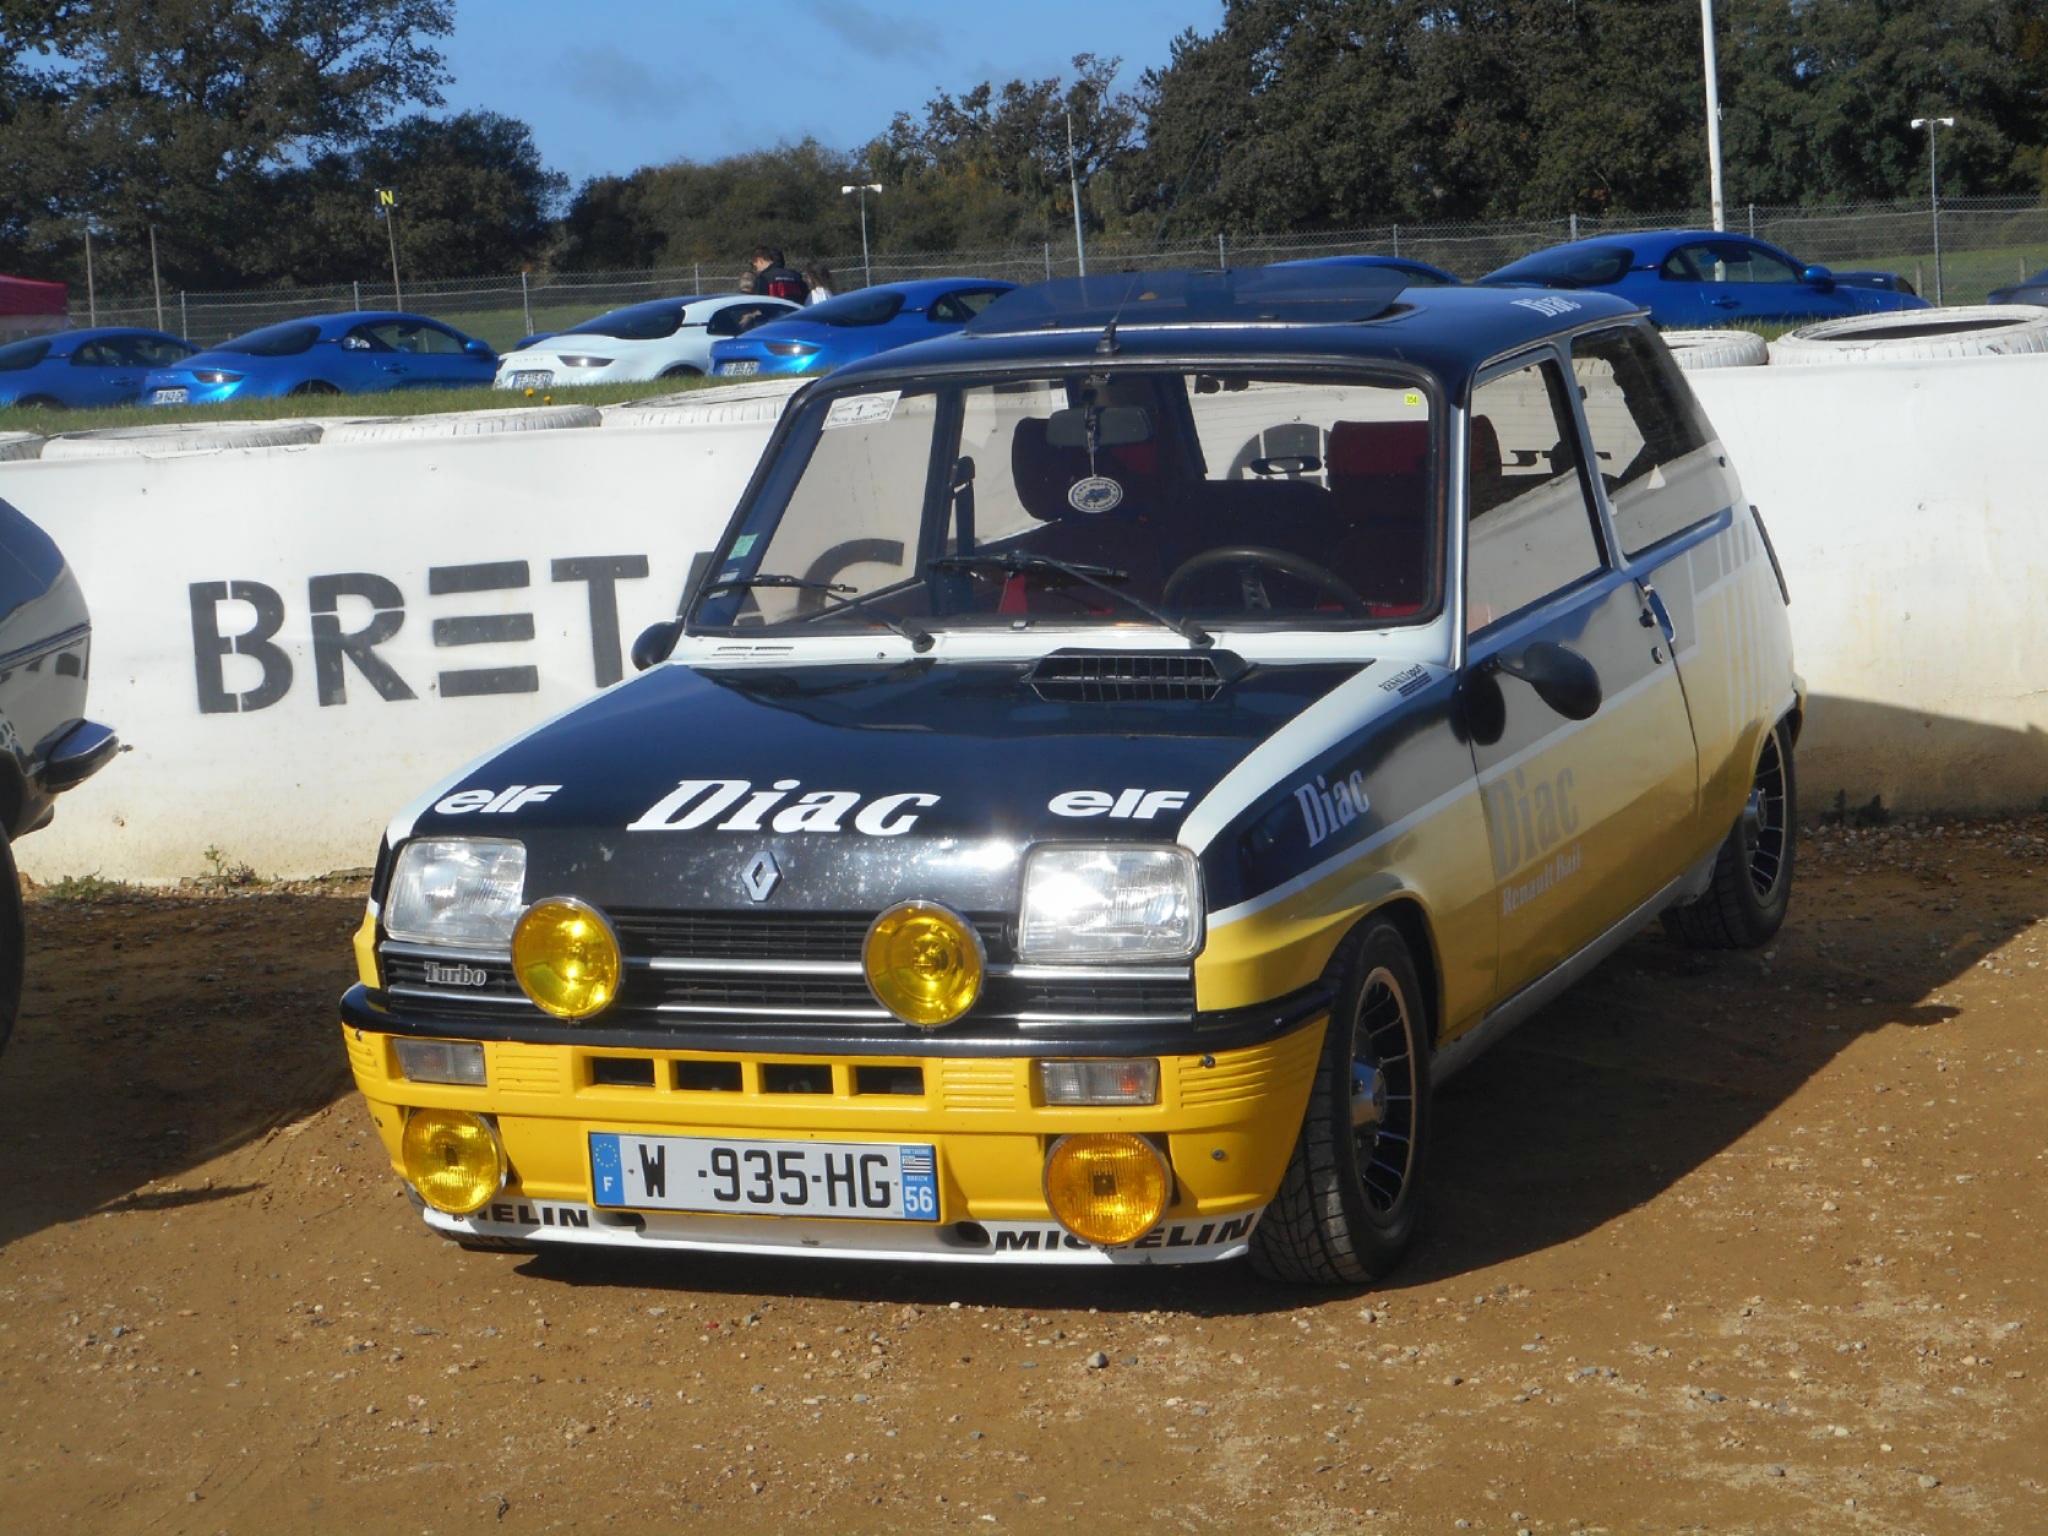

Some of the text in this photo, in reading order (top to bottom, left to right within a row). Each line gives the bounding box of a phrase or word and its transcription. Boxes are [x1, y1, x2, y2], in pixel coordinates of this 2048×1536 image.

[380, 190, 393, 205] N
[434, 784, 563, 814] elf
[626, 779, 941, 836] Diac
[1048, 788, 1190, 819] elf
[1294, 769, 1370, 848] Diac
[1487, 767, 1579, 879] Diac
[1503, 841, 1582, 916] Renault Bail
[423, 961, 487, 987] Turbo
[604, 1177, 614, 1192] F
[638, 1144, 666, 1199] W
[905, 1186, 933, 1213] 56
